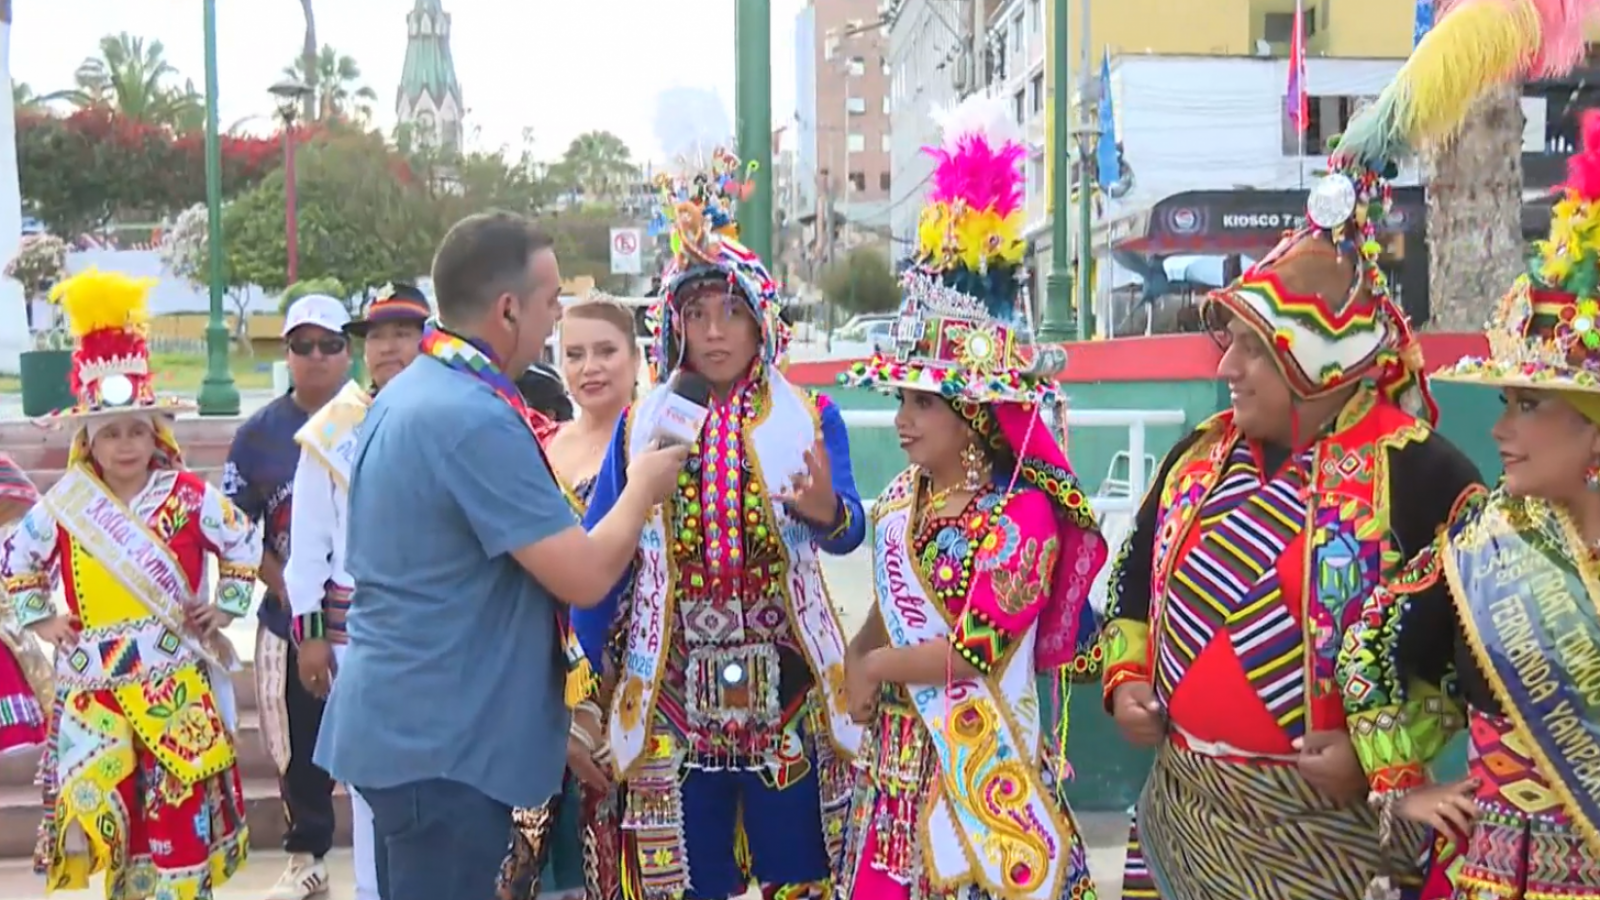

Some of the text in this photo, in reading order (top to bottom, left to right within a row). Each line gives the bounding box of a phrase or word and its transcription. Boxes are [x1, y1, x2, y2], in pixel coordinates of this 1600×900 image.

[1223, 213, 1280, 228] KIOSCO
[1282, 213, 1293, 227] 7
[647, 550, 665, 653] YUCRA
[1489, 594, 1559, 703] FERNANDA
